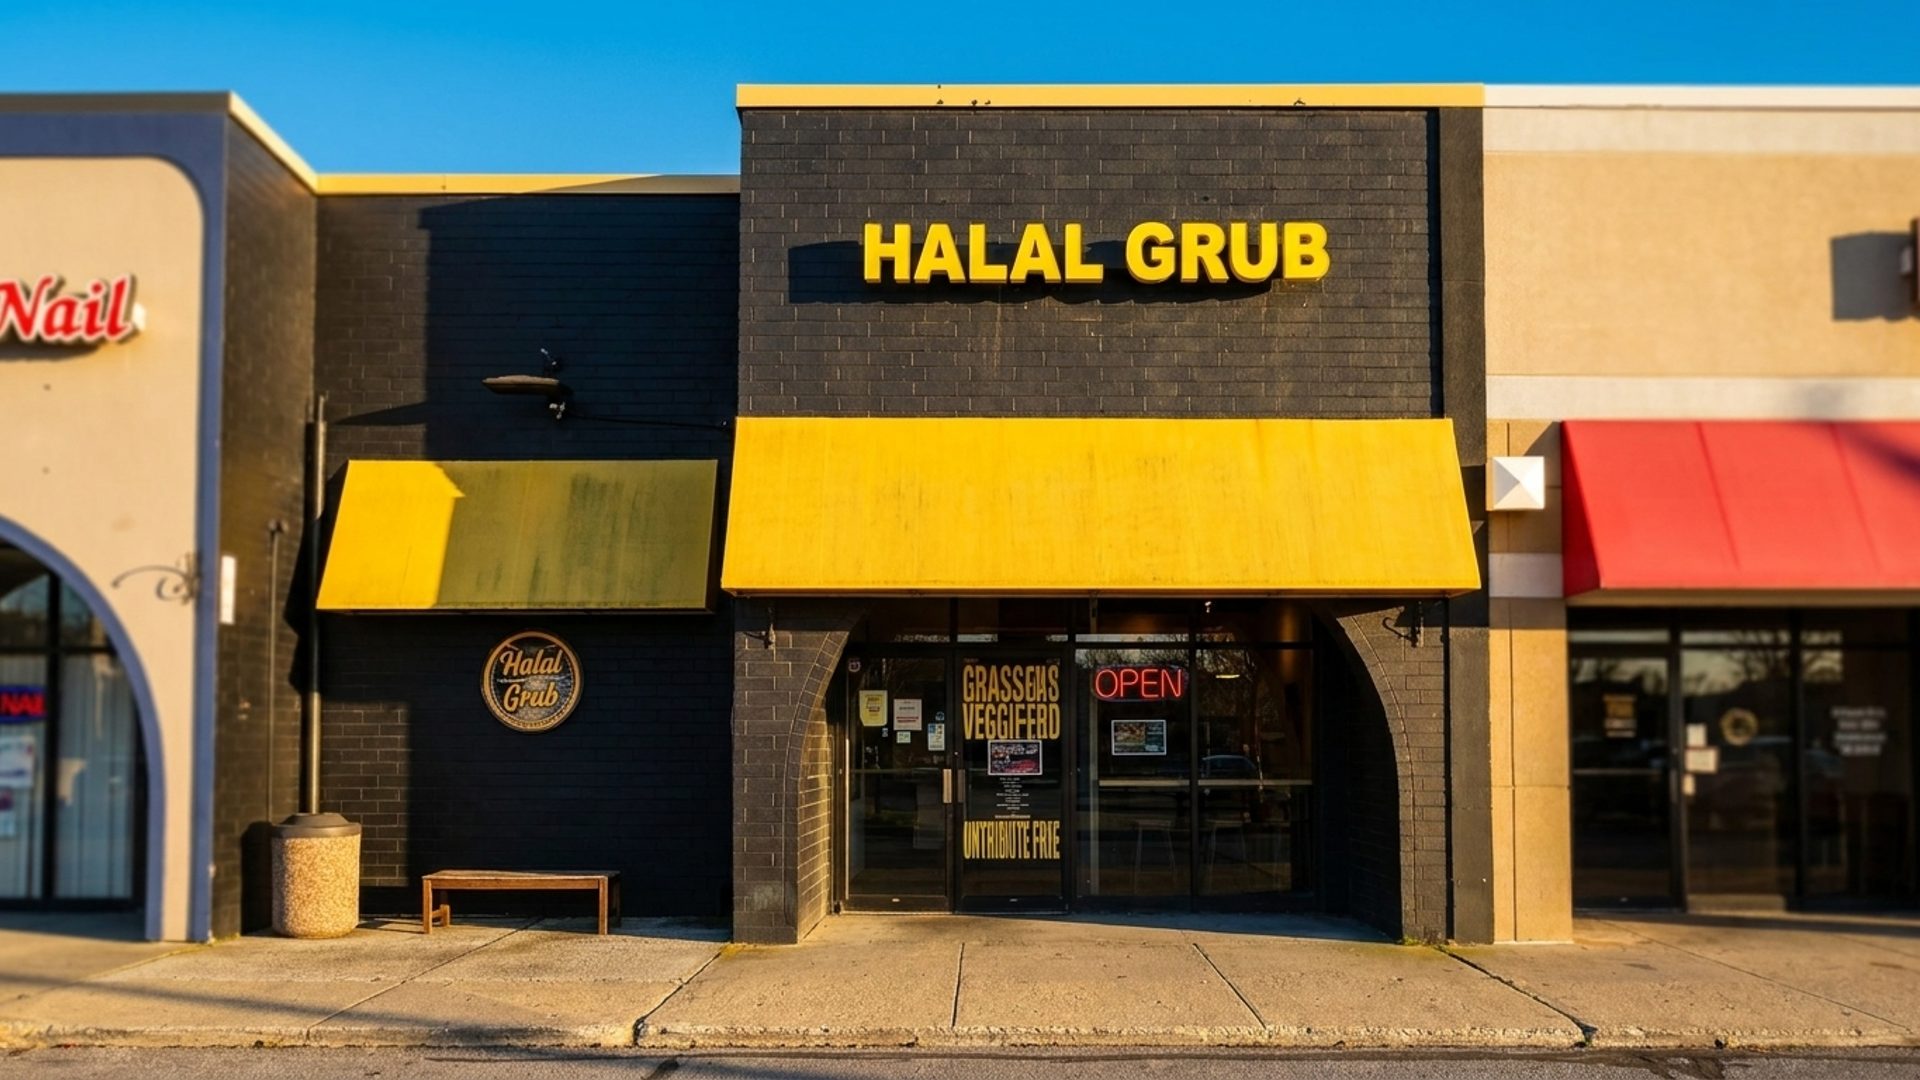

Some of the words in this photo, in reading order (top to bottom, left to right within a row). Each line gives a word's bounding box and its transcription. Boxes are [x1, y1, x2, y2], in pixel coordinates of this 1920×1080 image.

[864, 222, 1104, 284] HALAL
[1125, 220, 1331, 284] GRUB
[0, 274, 130, 340] Nail
[500, 649, 563, 677] Halal
[503, 681, 558, 712] Grub
[1095, 668, 1182, 698] OPEN
